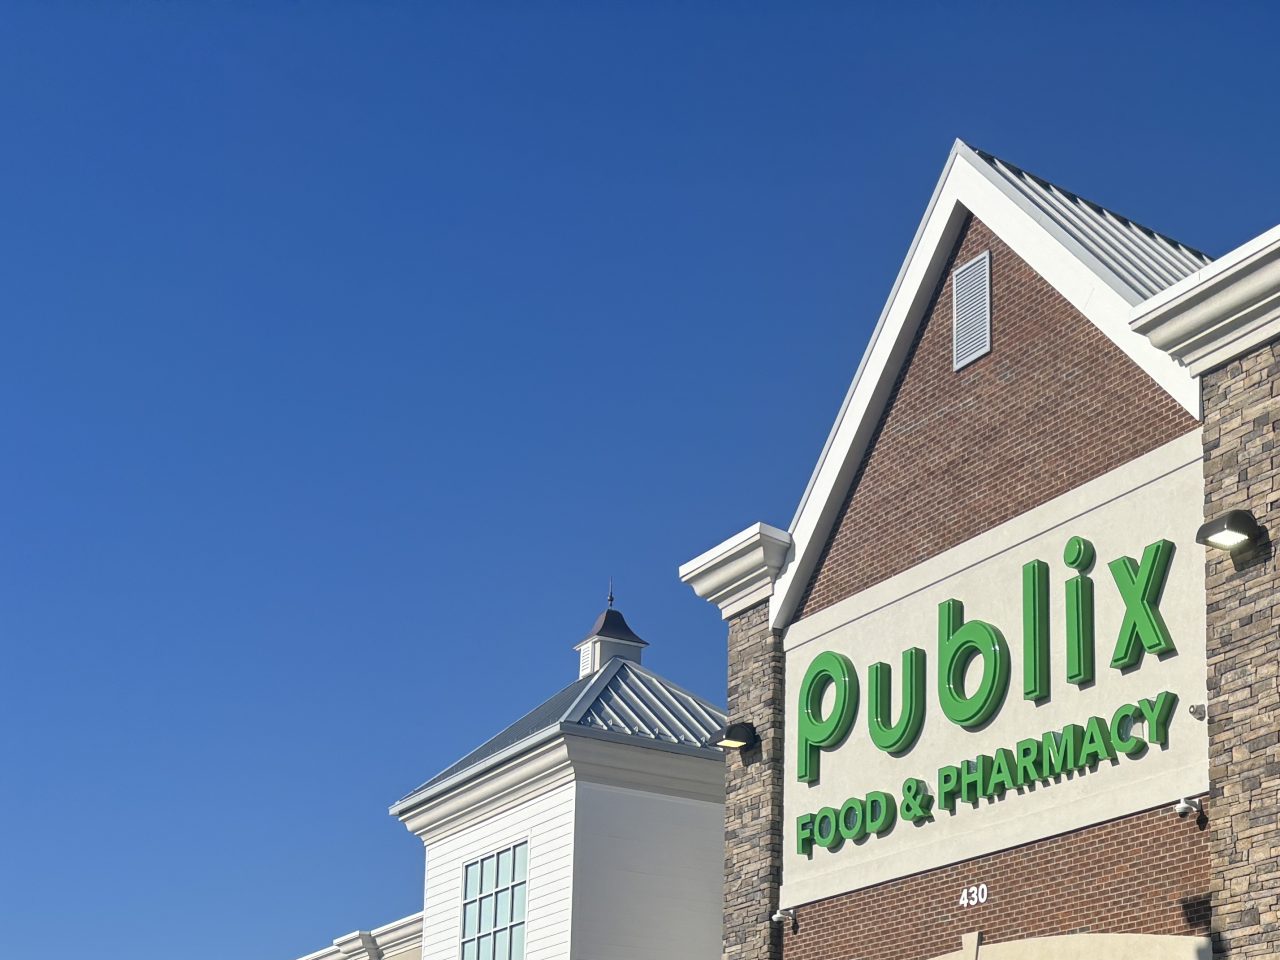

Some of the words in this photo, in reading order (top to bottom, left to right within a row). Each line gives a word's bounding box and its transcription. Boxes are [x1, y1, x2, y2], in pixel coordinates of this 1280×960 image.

[796, 790, 897, 857] FOOD
[900, 777, 935, 823] &
[938, 690, 1179, 810] PHARMACY
[959, 883, 988, 908] 430
